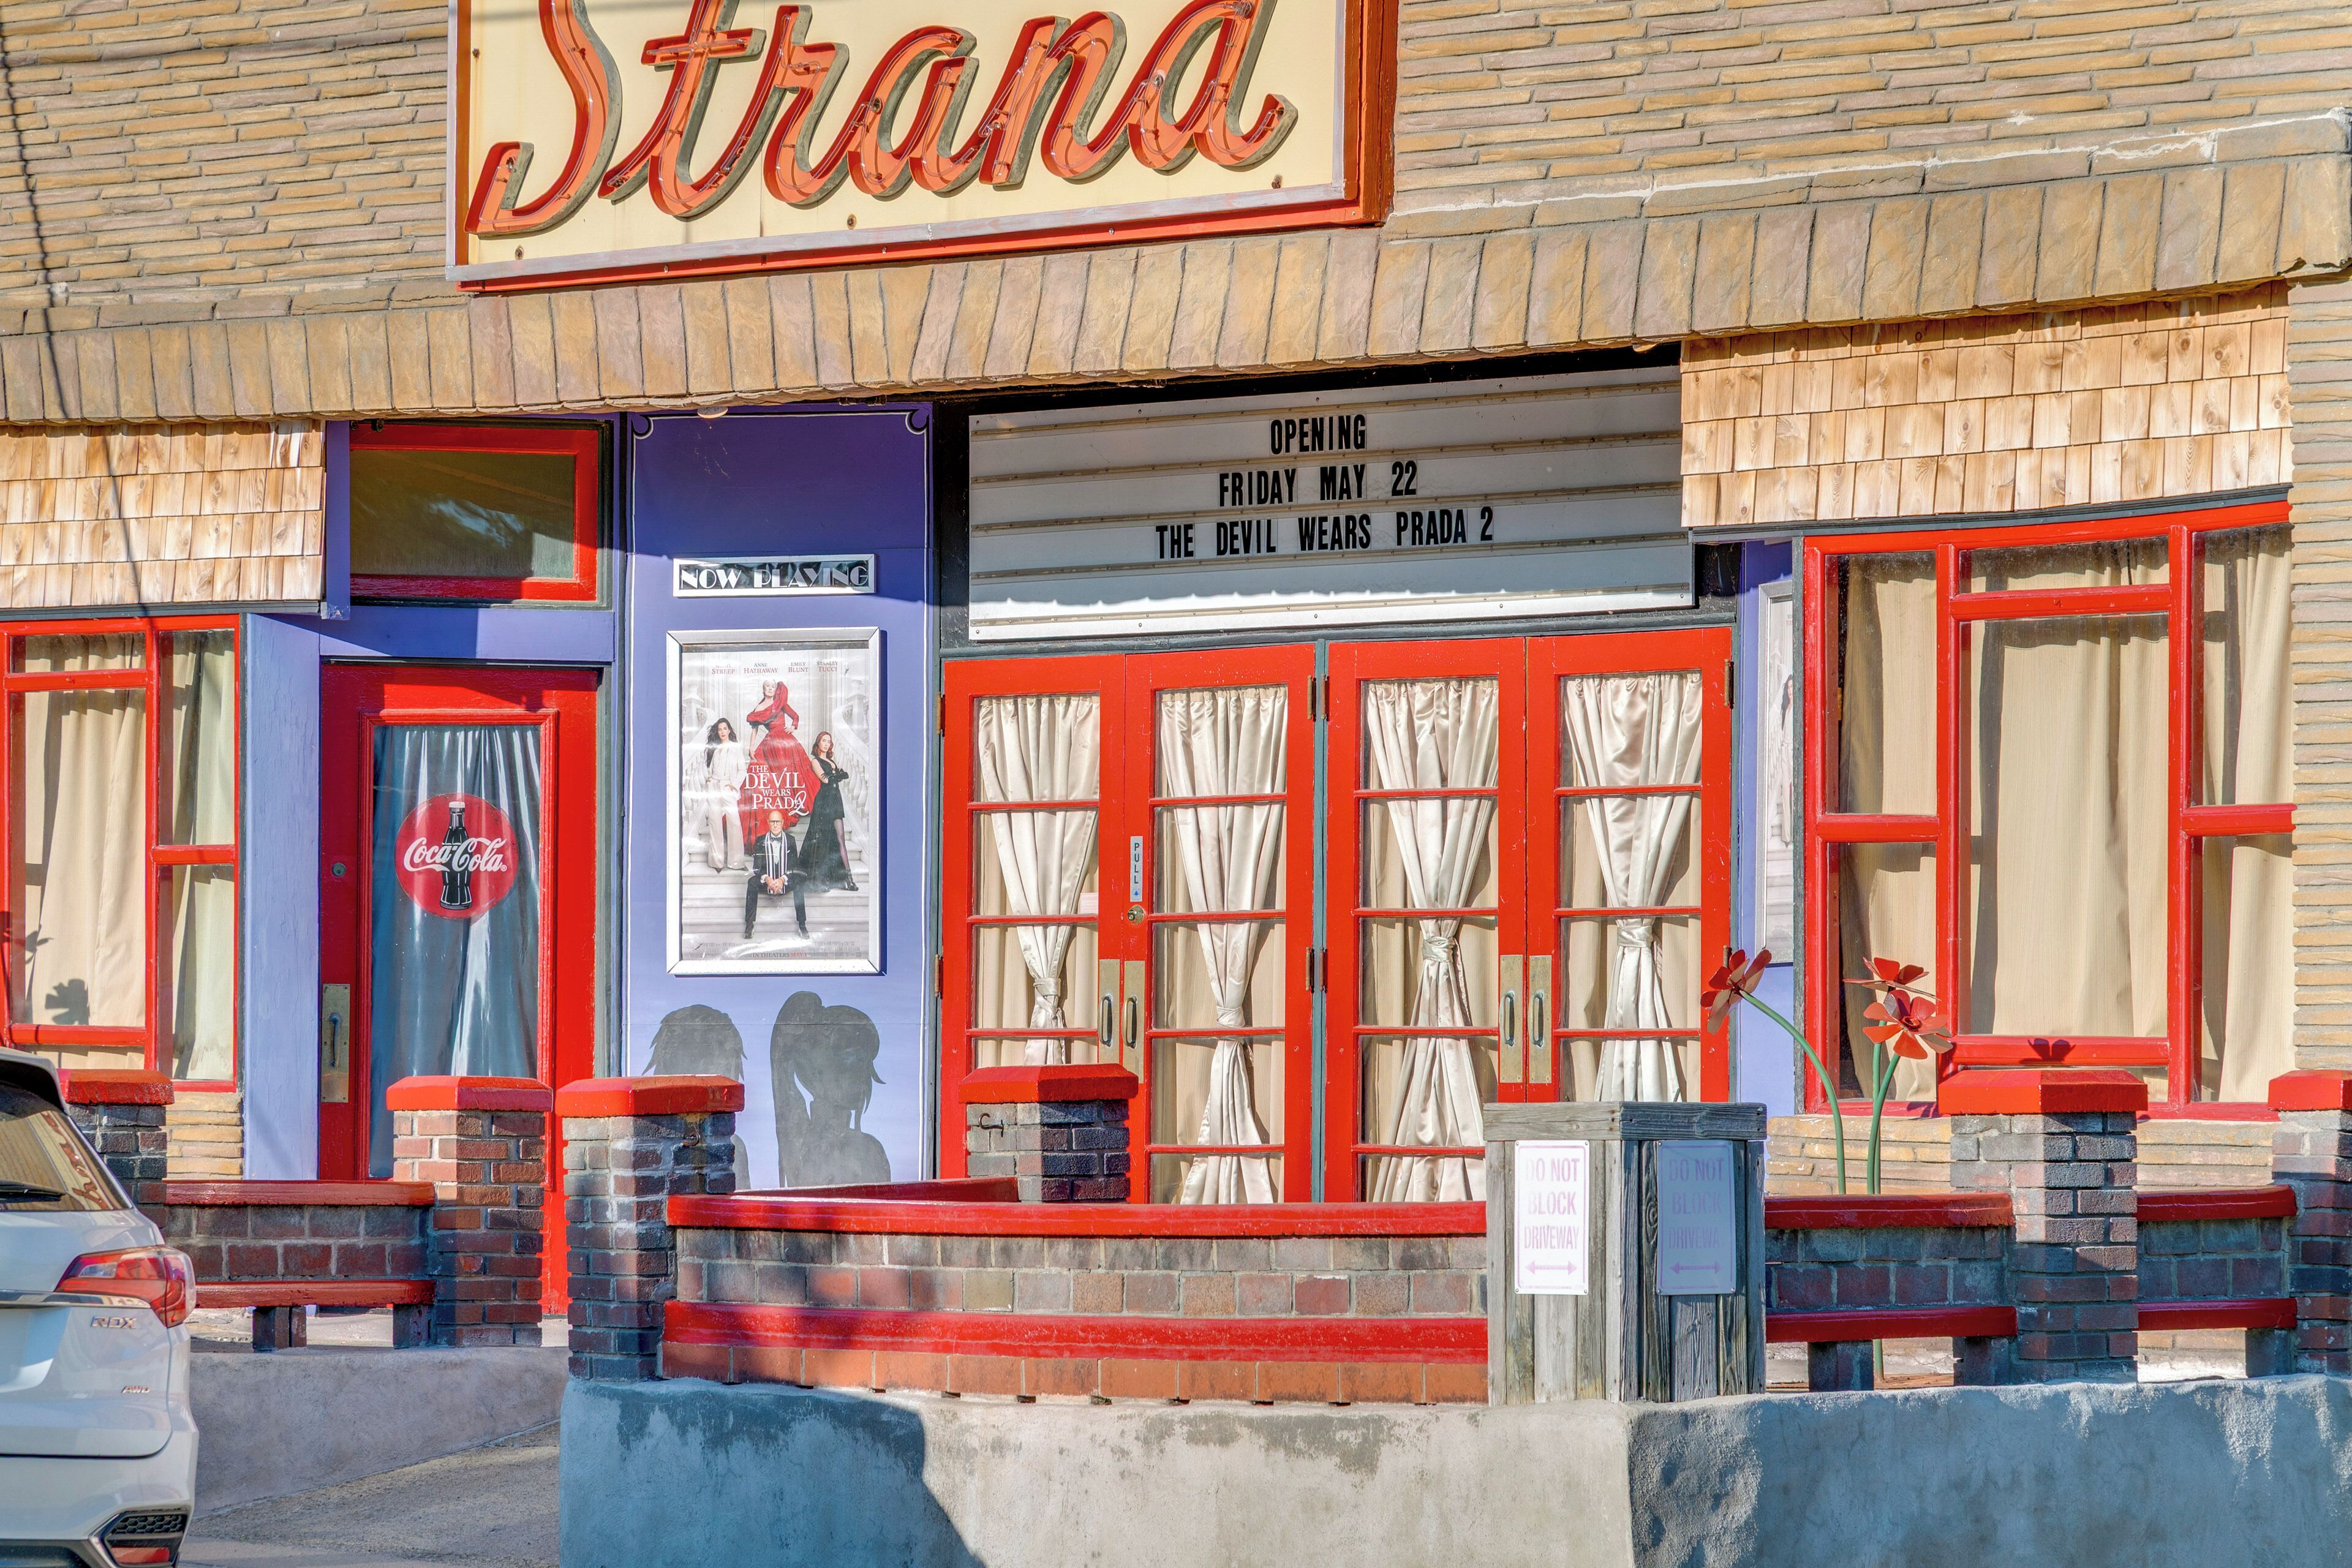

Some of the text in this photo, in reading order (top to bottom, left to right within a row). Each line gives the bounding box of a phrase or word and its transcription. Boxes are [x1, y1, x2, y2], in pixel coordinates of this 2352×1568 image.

[464, 0, 1297, 237] Strand
[1270, 414, 1366, 455] OPENING
[1219, 461, 1417, 507] FRIDAY MAY 22
[1156, 506, 1493, 560] THE DEVIL WEARS PRADA 2
[681, 566, 869, 589] NOW PLAYING
[744, 767, 805, 789] DEVIL
[752, 790, 809, 816] PRADA 2
[1526, 1157, 1580, 1182] DO NOT
[1669, 1158, 1724, 1182] DO NOT
[1528, 1191, 1577, 1215] BLOCK
[1672, 1191, 1722, 1215] BLOCK
[1524, 1226, 1579, 1249] DRIVEWAY
[1668, 1226, 1725, 1250] DRIVEWA
[91, 1316, 137, 1329] RDX
